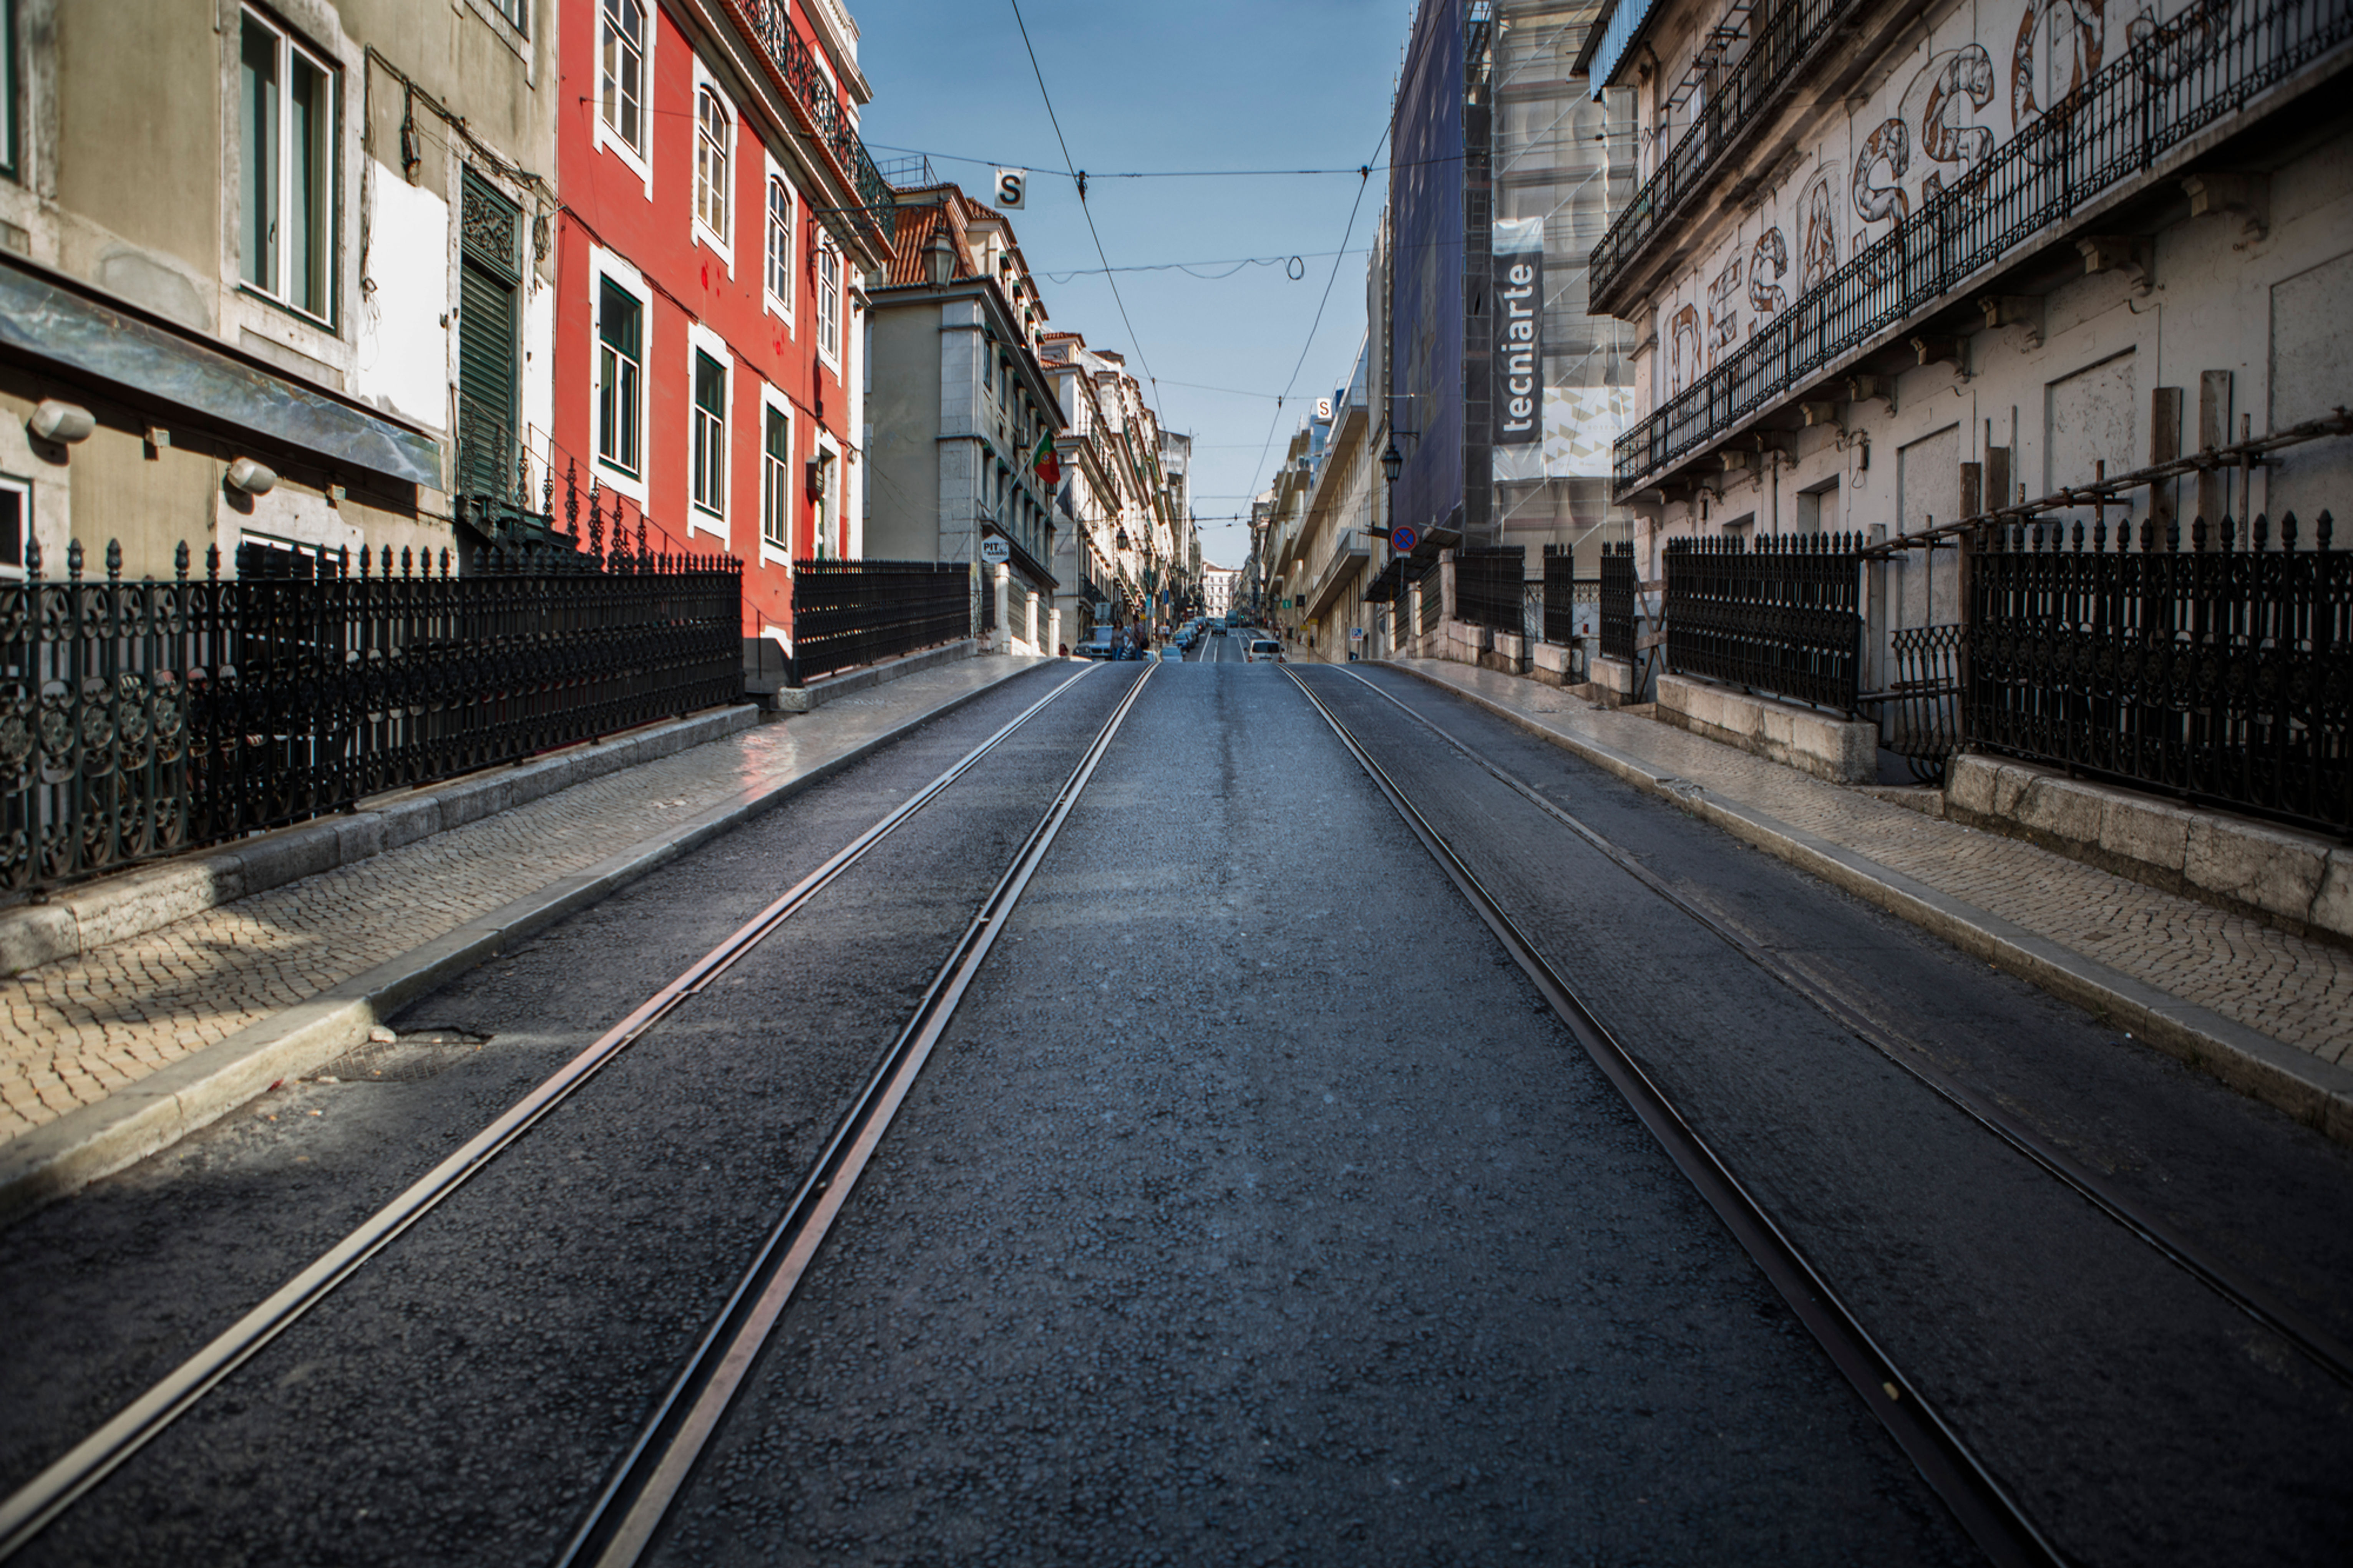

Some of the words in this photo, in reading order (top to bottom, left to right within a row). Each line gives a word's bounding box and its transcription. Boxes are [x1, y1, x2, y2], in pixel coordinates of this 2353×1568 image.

[999, 175, 1021, 204] S
[1502, 264, 1533, 432] tecniarte
[1320, 402, 1329, 416] S
